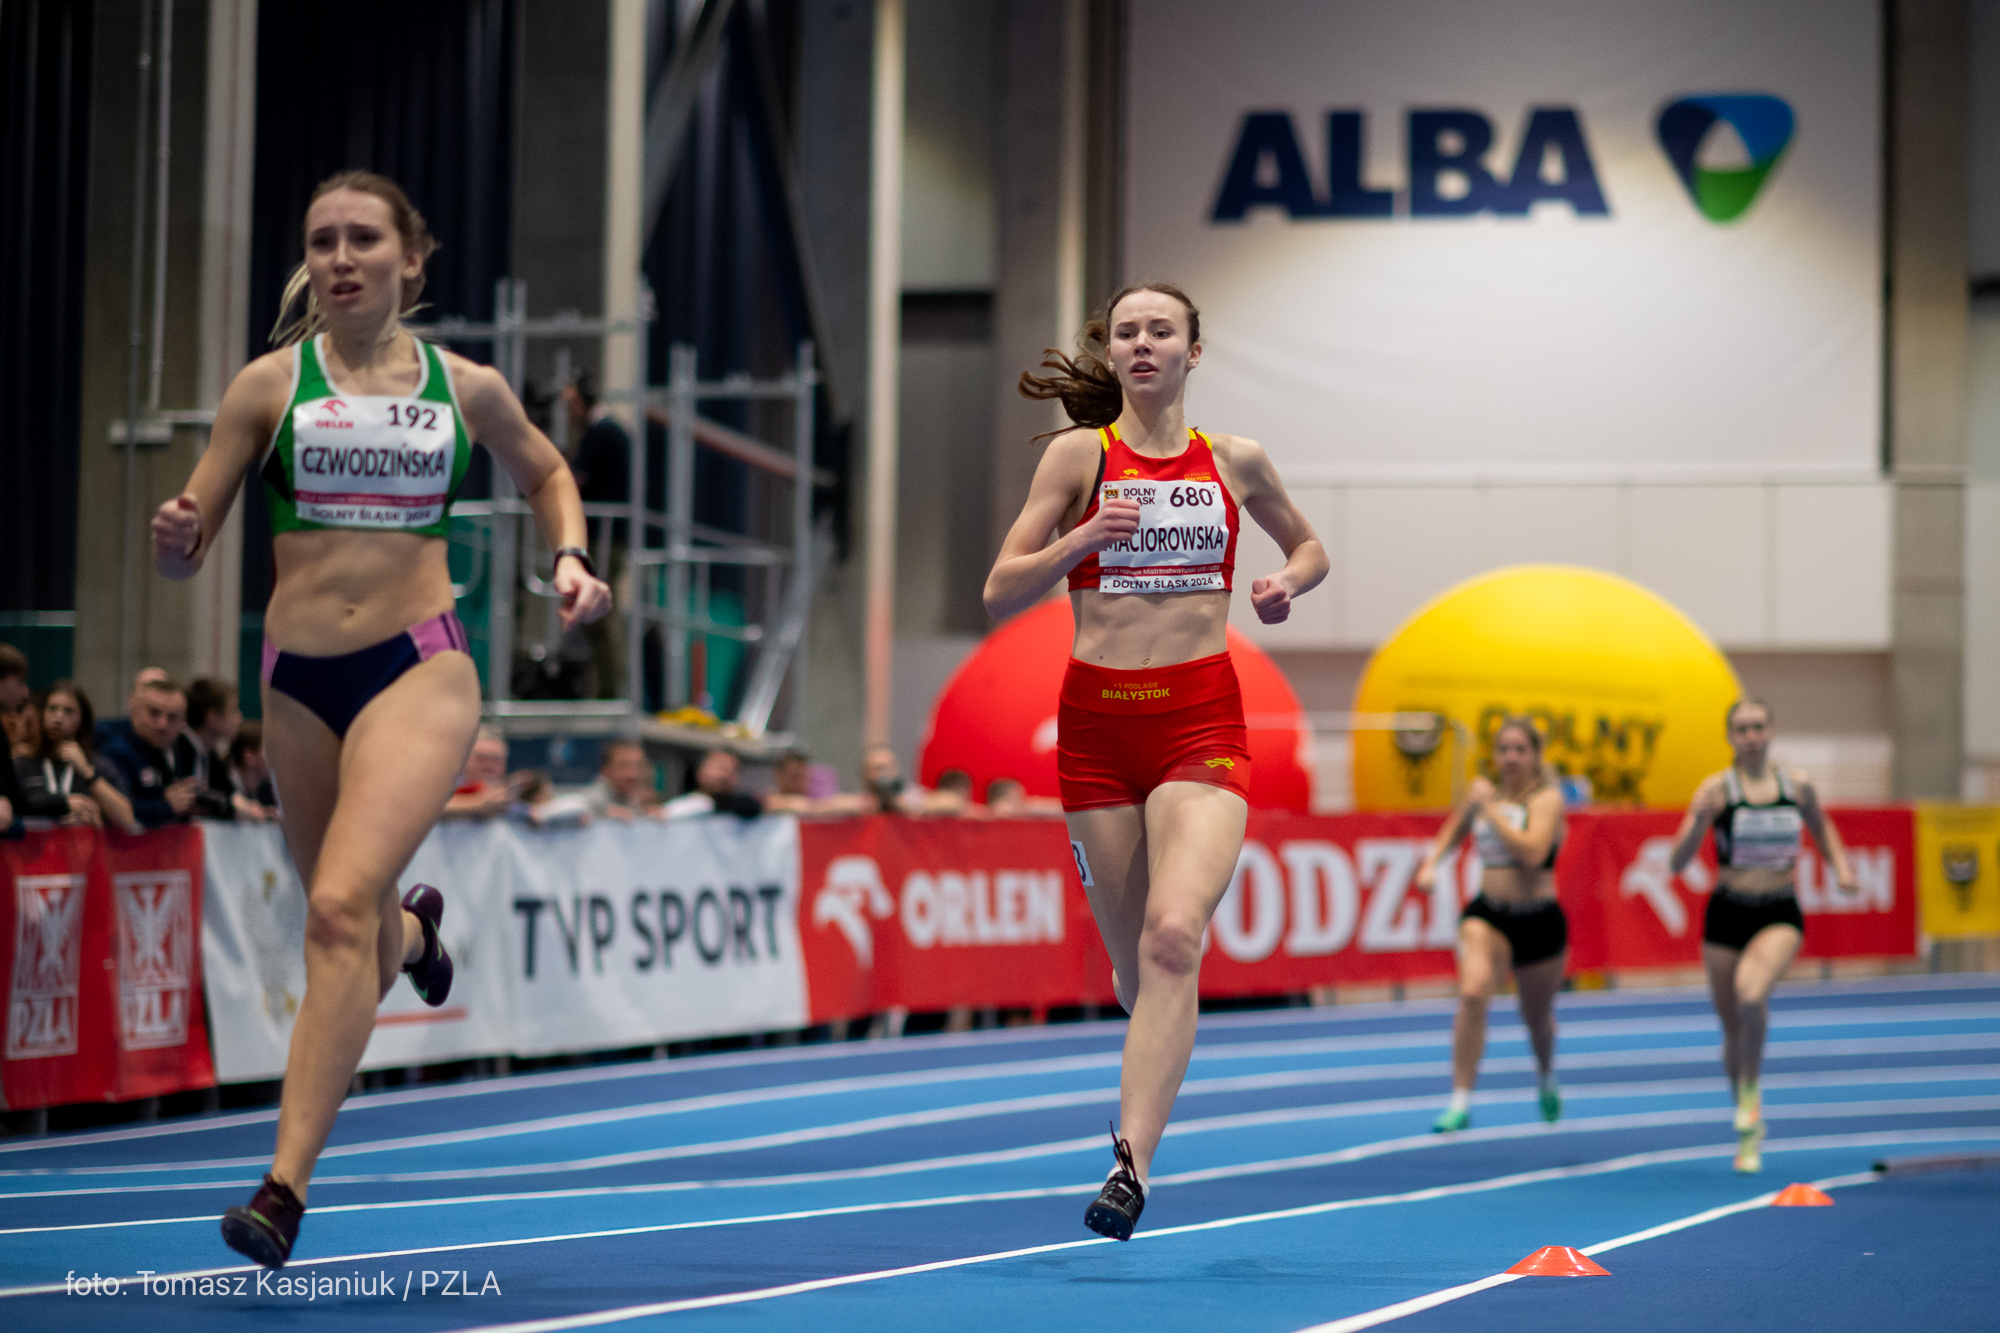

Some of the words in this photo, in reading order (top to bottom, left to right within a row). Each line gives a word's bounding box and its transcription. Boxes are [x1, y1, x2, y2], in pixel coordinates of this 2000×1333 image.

[1209, 106, 1613, 220] ALBA
[315, 420, 354, 429] ORLEN
[387, 404, 437, 430] 192
[302, 442, 446, 477] CZWODZIŃSKA
[1123, 488, 1156, 497] DOLNY
[1170, 486, 1213, 508] 680
[309, 506, 355, 521] DOLNY
[1113, 579, 1151, 589] DOLNY
[1154, 578, 1189, 590] ŚLĄSK
[1191, 577, 1214, 587] 2024
[1102, 688, 1170, 700] BIAŁYSTOK
[902, 870, 1065, 948] ORLEN
[512, 894, 617, 980] TVP
[631, 884, 785, 973] SPORT
